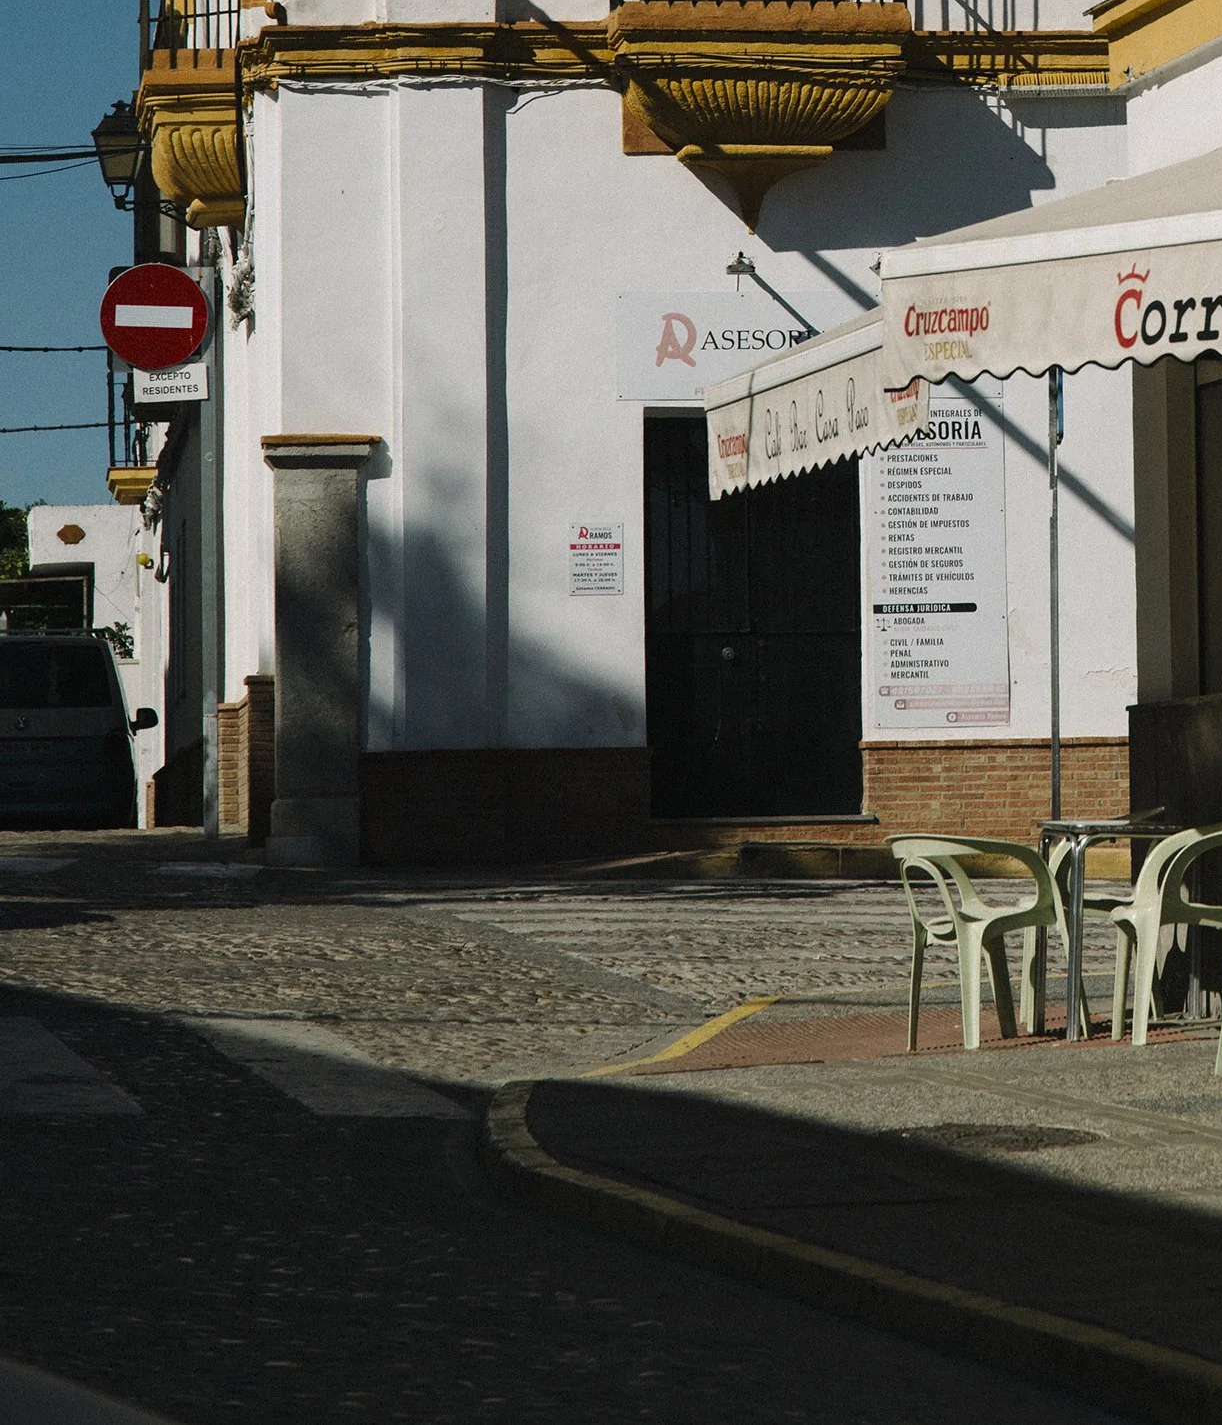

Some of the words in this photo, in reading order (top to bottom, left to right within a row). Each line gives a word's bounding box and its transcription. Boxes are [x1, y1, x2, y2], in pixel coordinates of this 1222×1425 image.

[903, 303, 990, 338] Cruzcampo
[923, 340, 974, 361] ESPECIAL
[149, 371, 192, 382] EXCEPTO
[142, 384, 199, 396] RESIDENTES
[815, 389, 839, 443] Casa
[930, 409, 972, 418] INTEGRALES
[974, 408, 983, 417] DE
[917, 418, 982, 440] SORÍA
[887, 454, 938, 463] PRESTACIONES
[887, 466, 918, 476] RÉGIMEN
[920, 467, 952, 475] ESPECIAL
[887, 480, 922, 489] DESPIDOS
[887, 494, 930, 502] ACCIDENTES
[931, 493, 941, 502] DE
[942, 493, 973, 501] TRABAJO
[887, 507, 939, 516] CONTABILIDAD
[888, 519, 918, 529] GESTIÓN
[919, 520, 929, 528] DE
[930, 519, 970, 528] IMPUESTOS
[589, 531, 613, 540] RAMOS
[888, 533, 915, 542] RENTAS
[888, 547, 923, 555] REGISTRO
[924, 546, 964, 555] MERCANTIL
[888, 559, 918, 569] GESTIÓN
[920, 560, 929, 568] DE
[930, 559, 964, 568] SEGUROS
[889, 572, 923, 582] TRÁMITES
[925, 573, 934, 581] DE
[936, 571, 975, 581] VEHÍCULOS
[889, 586, 928, 595] HERENCIAS
[882, 604, 915, 613] DEFENSA
[917, 603, 951, 612] JURÍDICA
[893, 617, 925, 625] ABOGADA
[890, 638, 908, 647] CIVIL
[916, 638, 944, 646] FAMILIA
[890, 649, 912, 657] PENAL
[890, 660, 949, 668] ADMINISTRATIVO
[890, 670, 930, 679] MERCANTIL
